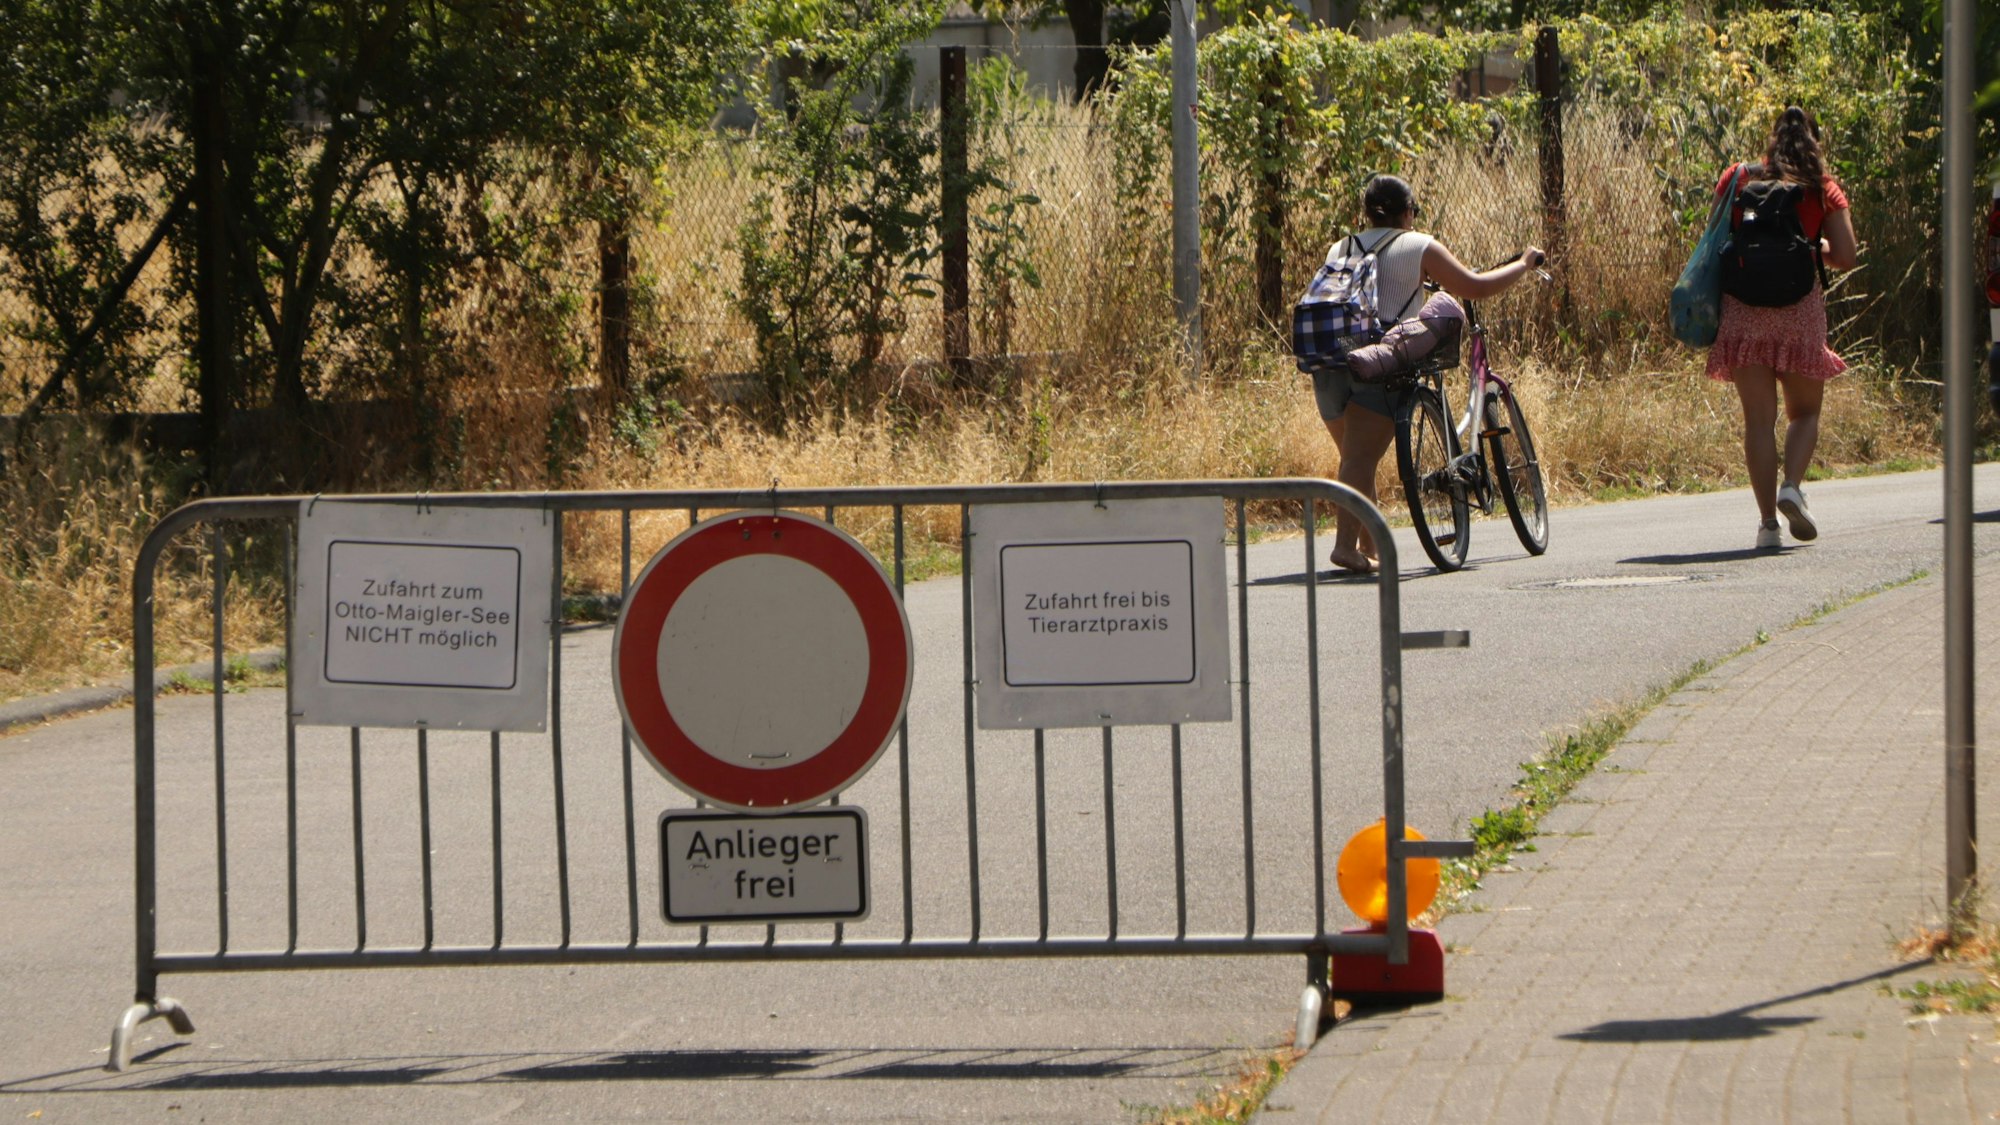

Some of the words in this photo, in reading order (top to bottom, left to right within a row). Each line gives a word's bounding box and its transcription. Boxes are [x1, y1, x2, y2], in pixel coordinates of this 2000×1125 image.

[363, 579, 436, 599] Zufahrt
[440, 586, 483, 600] zum
[1025, 593, 1098, 610] Zufahrt
[1103, 592, 1135, 608] frei
[1142, 590, 1171, 608] bis
[335, 601, 510, 626] Otto-Maigler-See
[1028, 615, 1169, 636] Tierarztpraxis
[345, 625, 413, 644] NICHT
[419, 630, 498, 650] möglich
[686, 829, 840, 864] Anlieger
[734, 868, 795, 900] frei
